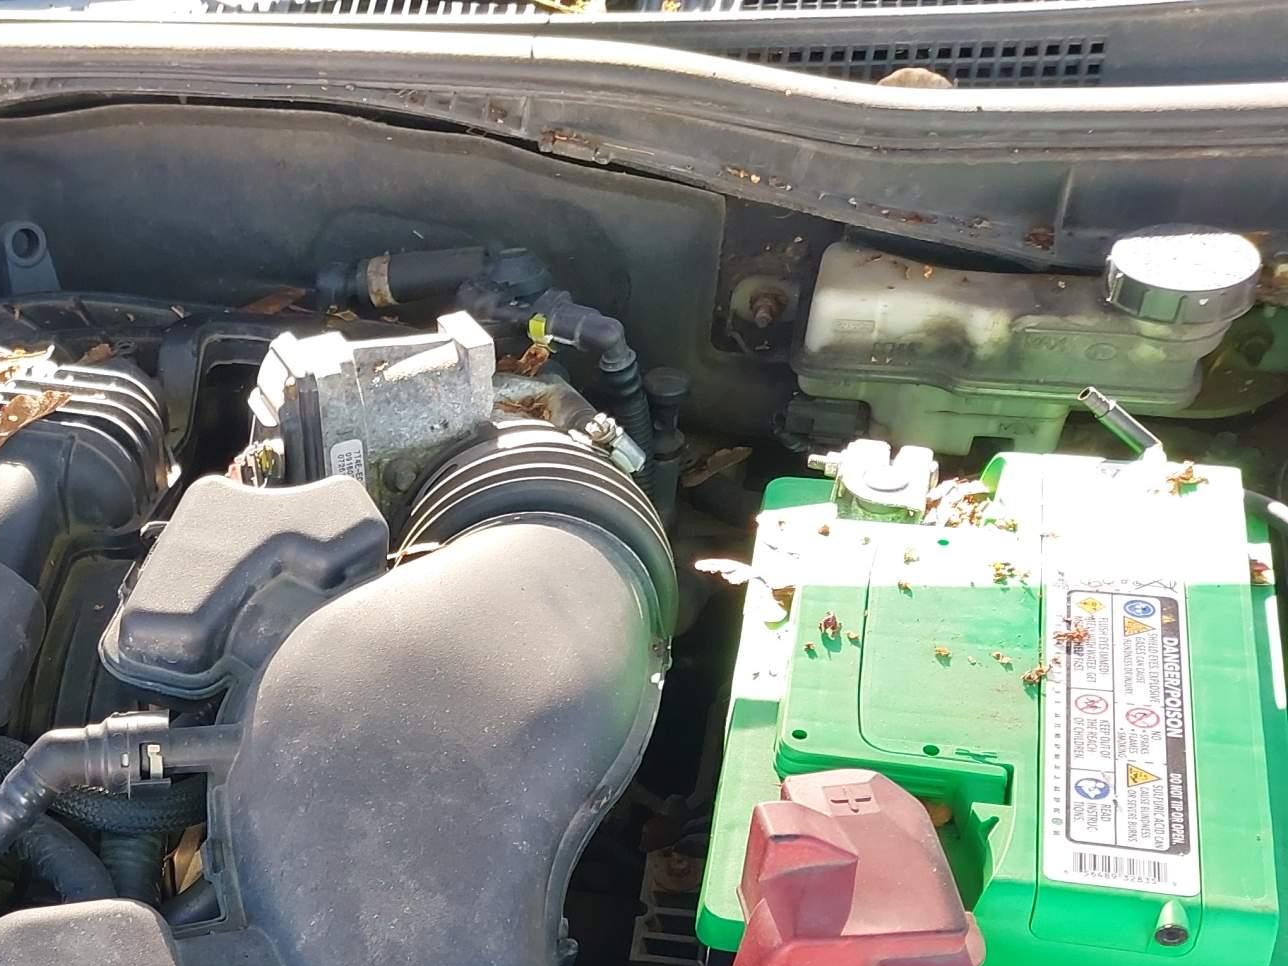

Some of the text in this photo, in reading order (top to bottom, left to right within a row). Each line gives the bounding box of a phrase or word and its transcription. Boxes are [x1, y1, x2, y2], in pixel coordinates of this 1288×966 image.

[1098, 618, 1109, 635] FLUSH
[1073, 641, 1084, 656] HELP
[1099, 637, 1109, 649] EYES
[1148, 633, 1160, 653] SHIELD
[1135, 637, 1146, 684] GASES CAN CAUSE
[1086, 672, 1096, 683] GET
[1149, 671, 1161, 703] EXPLOSIVE
[1163, 637, 1183, 738] DANGER/POISON
[1073, 717, 1084, 726] OF
[1087, 719, 1098, 752] THE REACH
[1100, 720, 1110, 759] KEEP OUT OF
[1117, 732, 1127, 759] SMOKING
[1128, 733, 1138, 754] FLAMES
[1140, 734, 1150, 754] SPARKS
[1128, 790, 1137, 798] OR
[1100, 804, 1111, 822] READ
[1128, 800, 1137, 820] SEVERE
[1140, 787, 1151, 838] CAUSE BLINDNESS
[1152, 785, 1165, 849] SULFURIC ACID CAN
[1170, 773, 1184, 845] DO NOT TIP OR OPEN.
